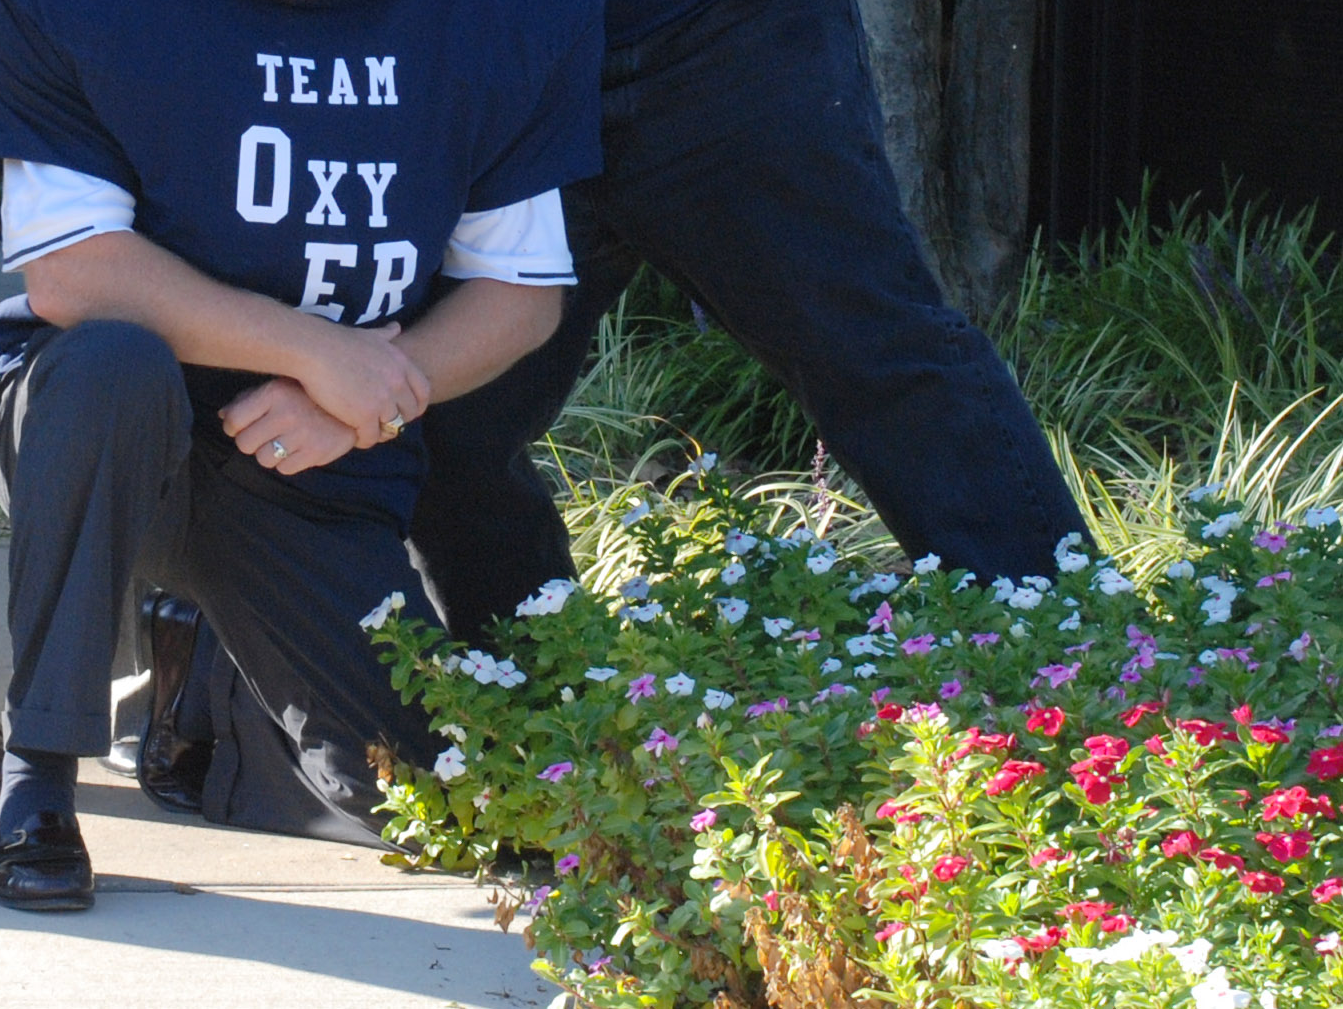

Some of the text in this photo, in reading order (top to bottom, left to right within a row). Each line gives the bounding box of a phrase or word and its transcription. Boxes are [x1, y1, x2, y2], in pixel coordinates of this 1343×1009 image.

[257, 53, 398, 105] TEAM
[236, 125, 397, 228] OXY
[293, 240, 418, 325] ER
